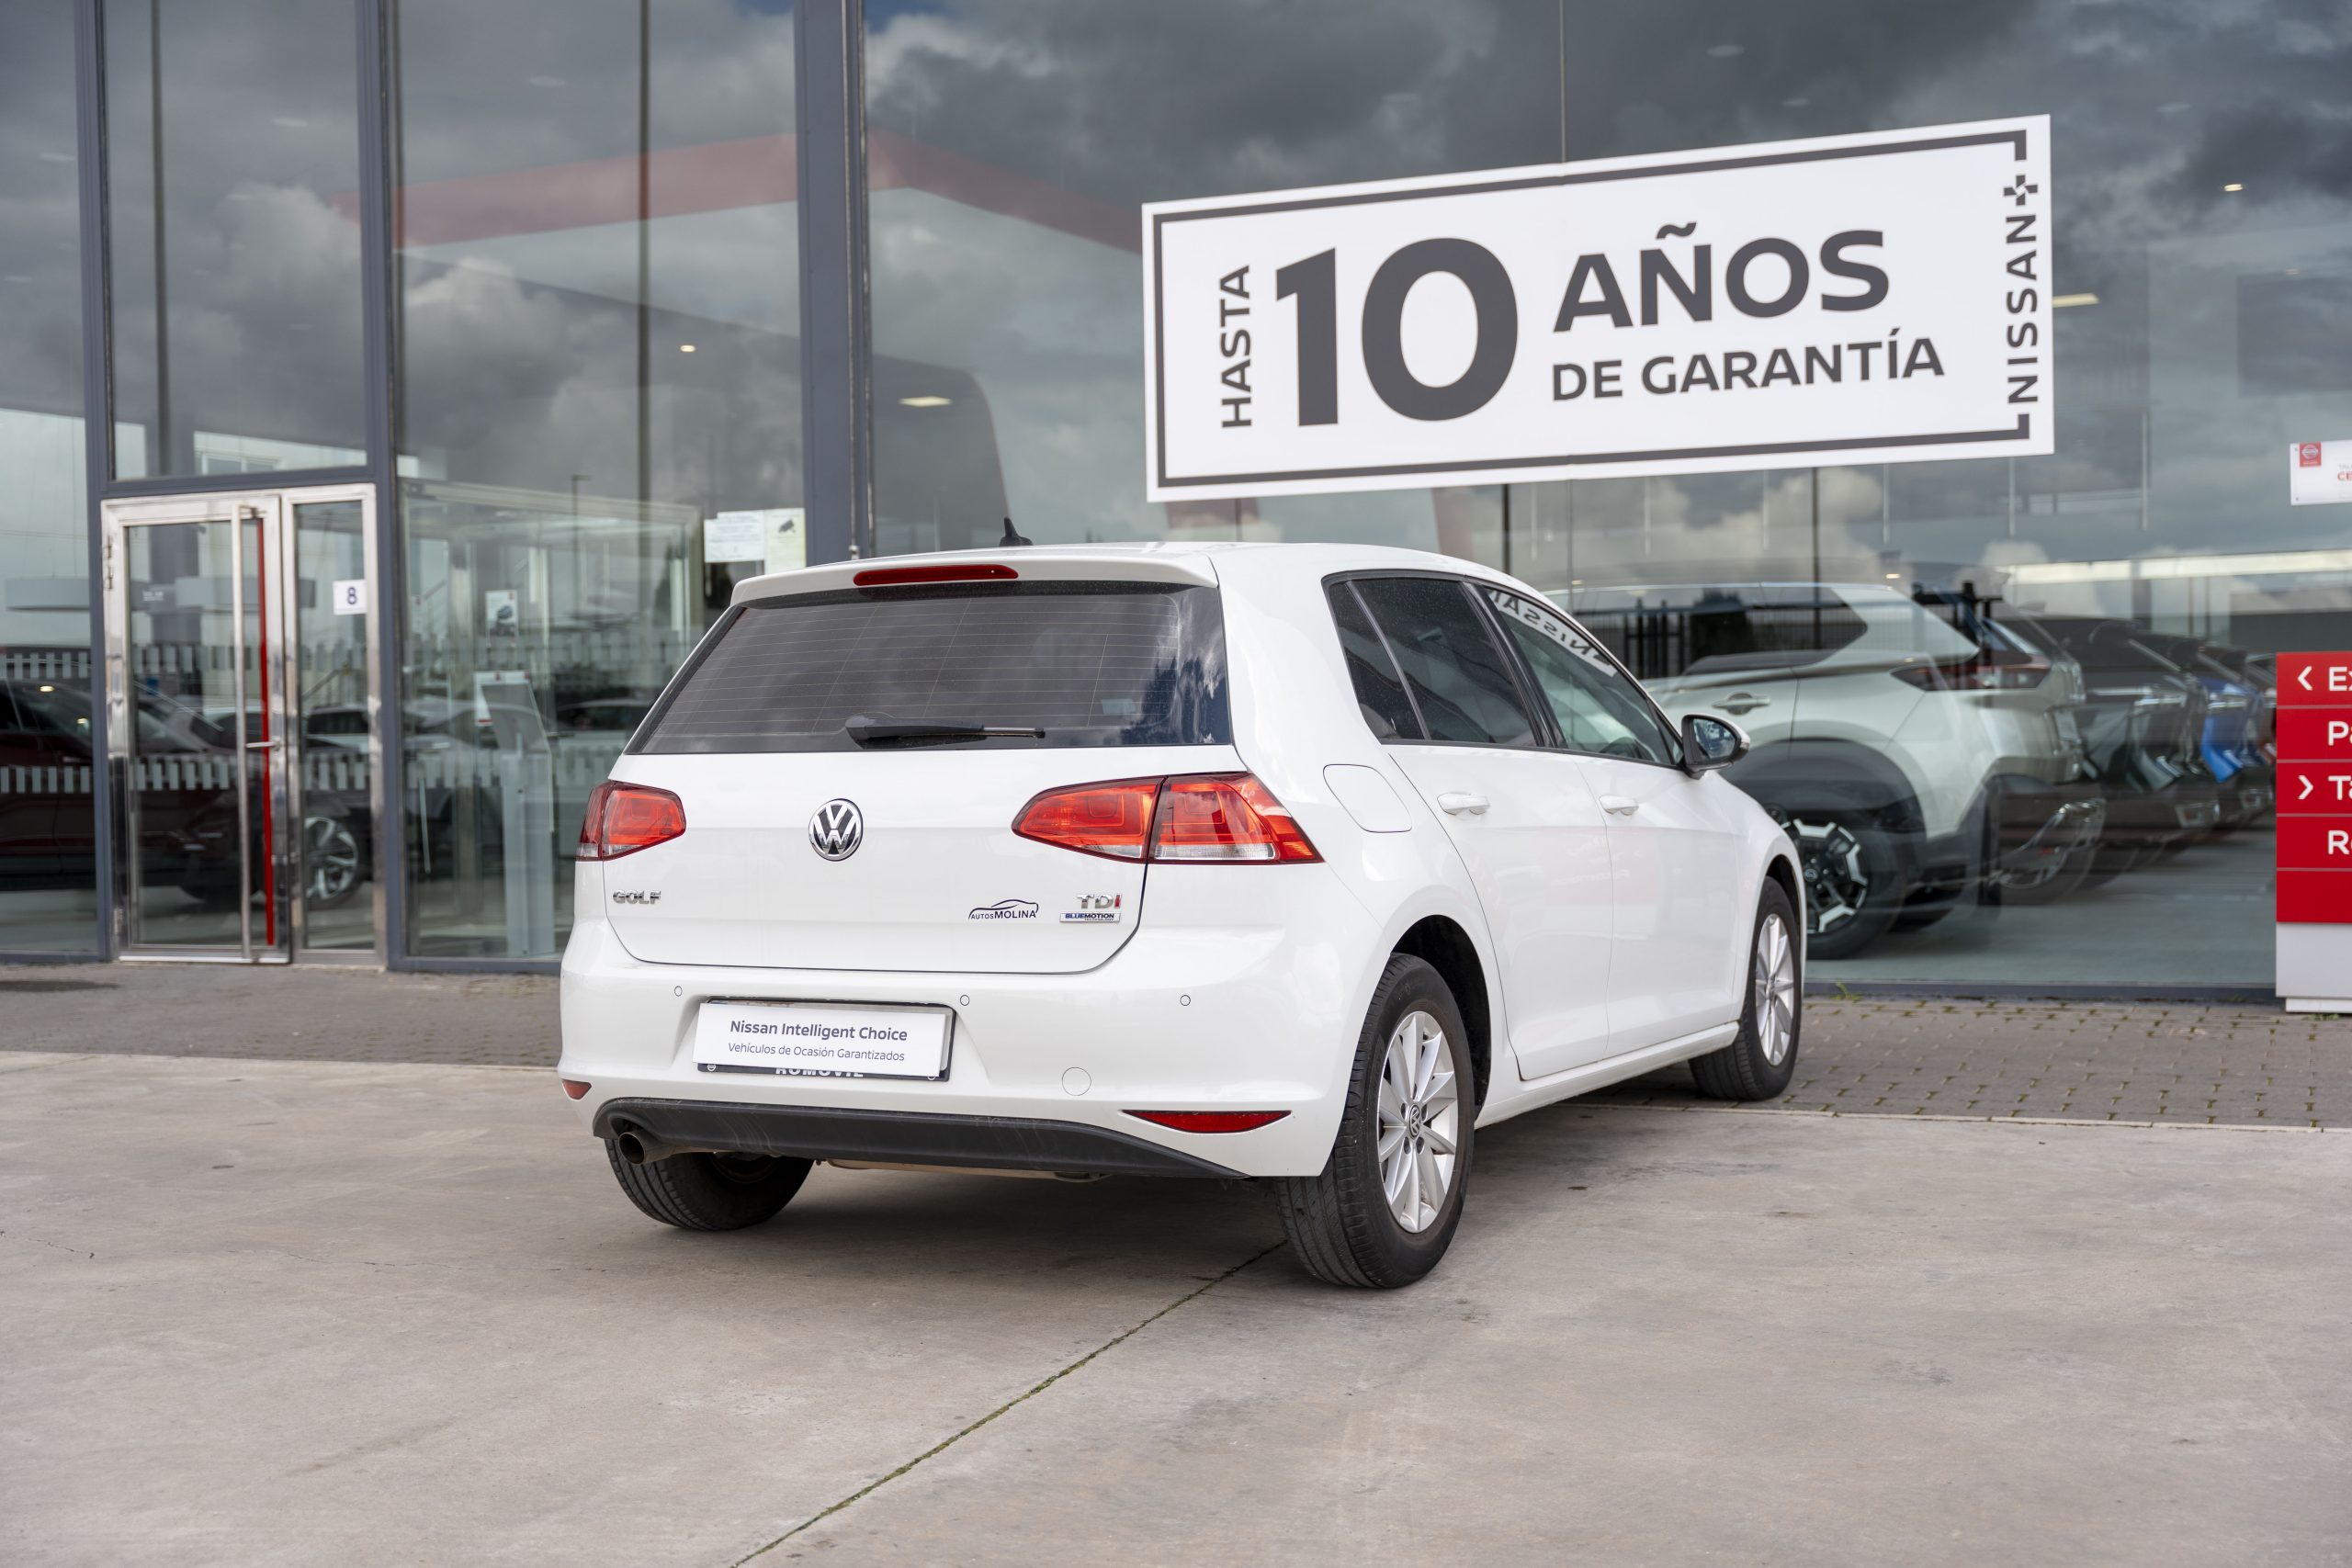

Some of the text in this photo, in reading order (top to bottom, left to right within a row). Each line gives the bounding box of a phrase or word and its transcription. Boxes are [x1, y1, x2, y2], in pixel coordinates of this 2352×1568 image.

[1553, 221, 1890, 333] AÑOS
[2006, 214, 2038, 404] NISSAN
[1275, 237, 1519, 427] 10
[1219, 265, 1252, 427] HASTA
[1553, 327, 1945, 401] DE GARANTÍA
[346, 586, 357, 605] 8
[2328, 666, 2352, 692] E
[2327, 721, 2352, 746] P
[2327, 775, 2352, 801] T
[809, 799, 863, 862] VW
[2327, 829, 2352, 855] R
[612, 889, 662, 905] GOLF
[1077, 894, 1121, 908] TDI
[730, 1021, 908, 1041] Nissan Intelligent Choice
[778, 1045, 791, 1055] de
[793, 1046, 835, 1057] Ocasión
[837, 1048, 905, 1061] Garantizados
